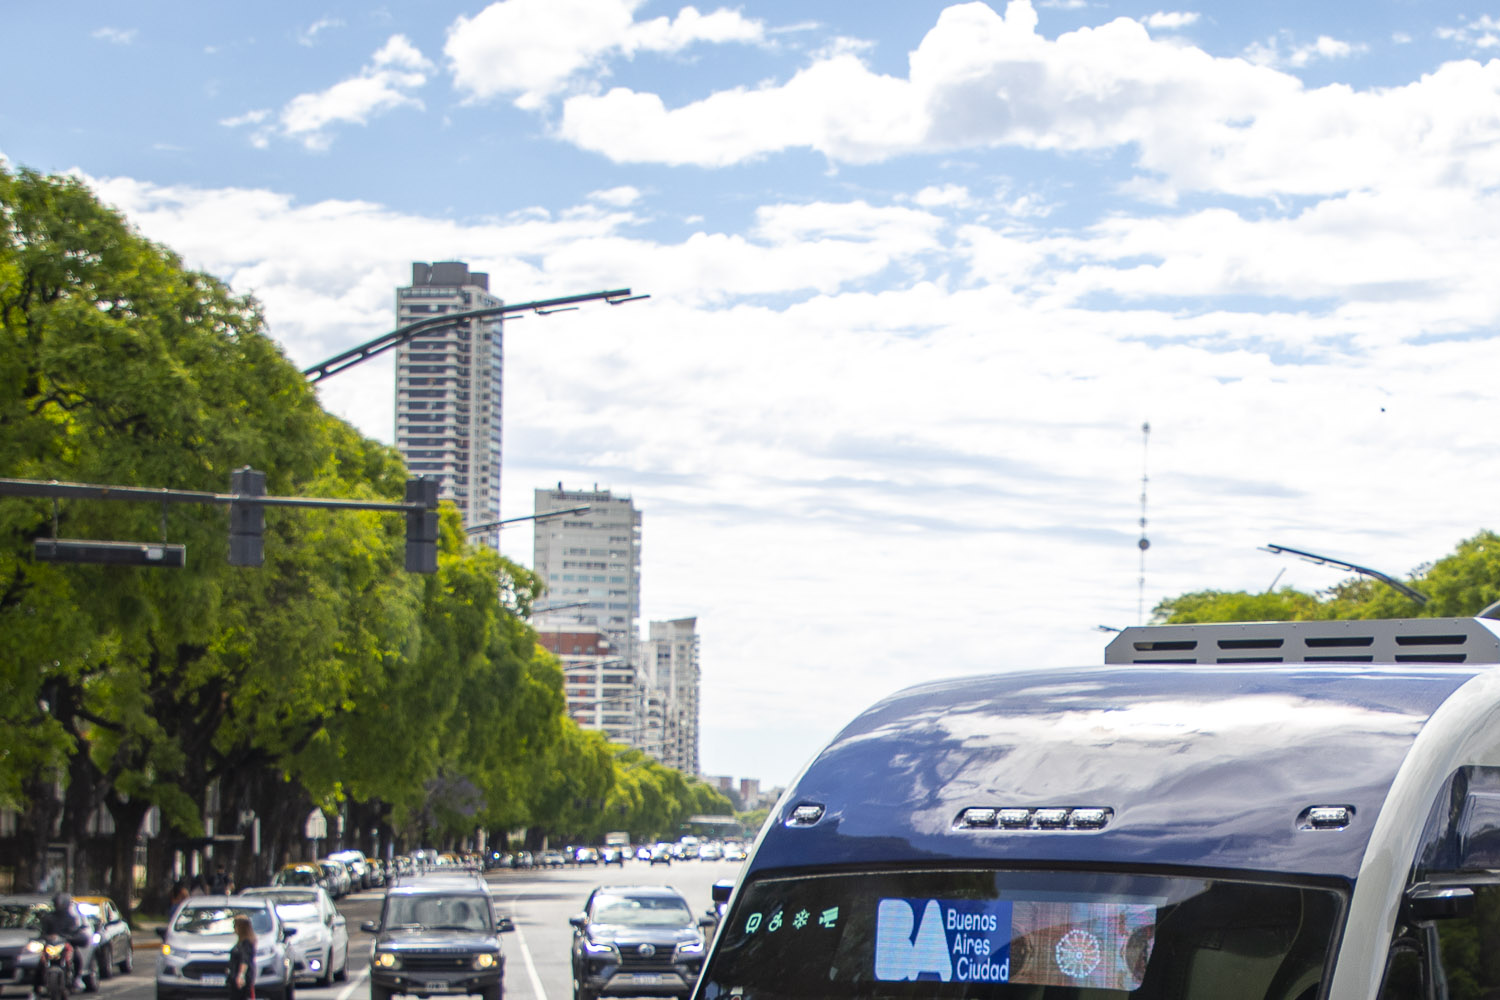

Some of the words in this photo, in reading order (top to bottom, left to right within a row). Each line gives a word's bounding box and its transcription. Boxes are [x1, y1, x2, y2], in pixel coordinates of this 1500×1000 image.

[947, 908, 997, 932] Buenos
[874, 898, 953, 983] BA
[953, 934, 990, 955] Aires
[956, 957, 1010, 982] Ciudad
